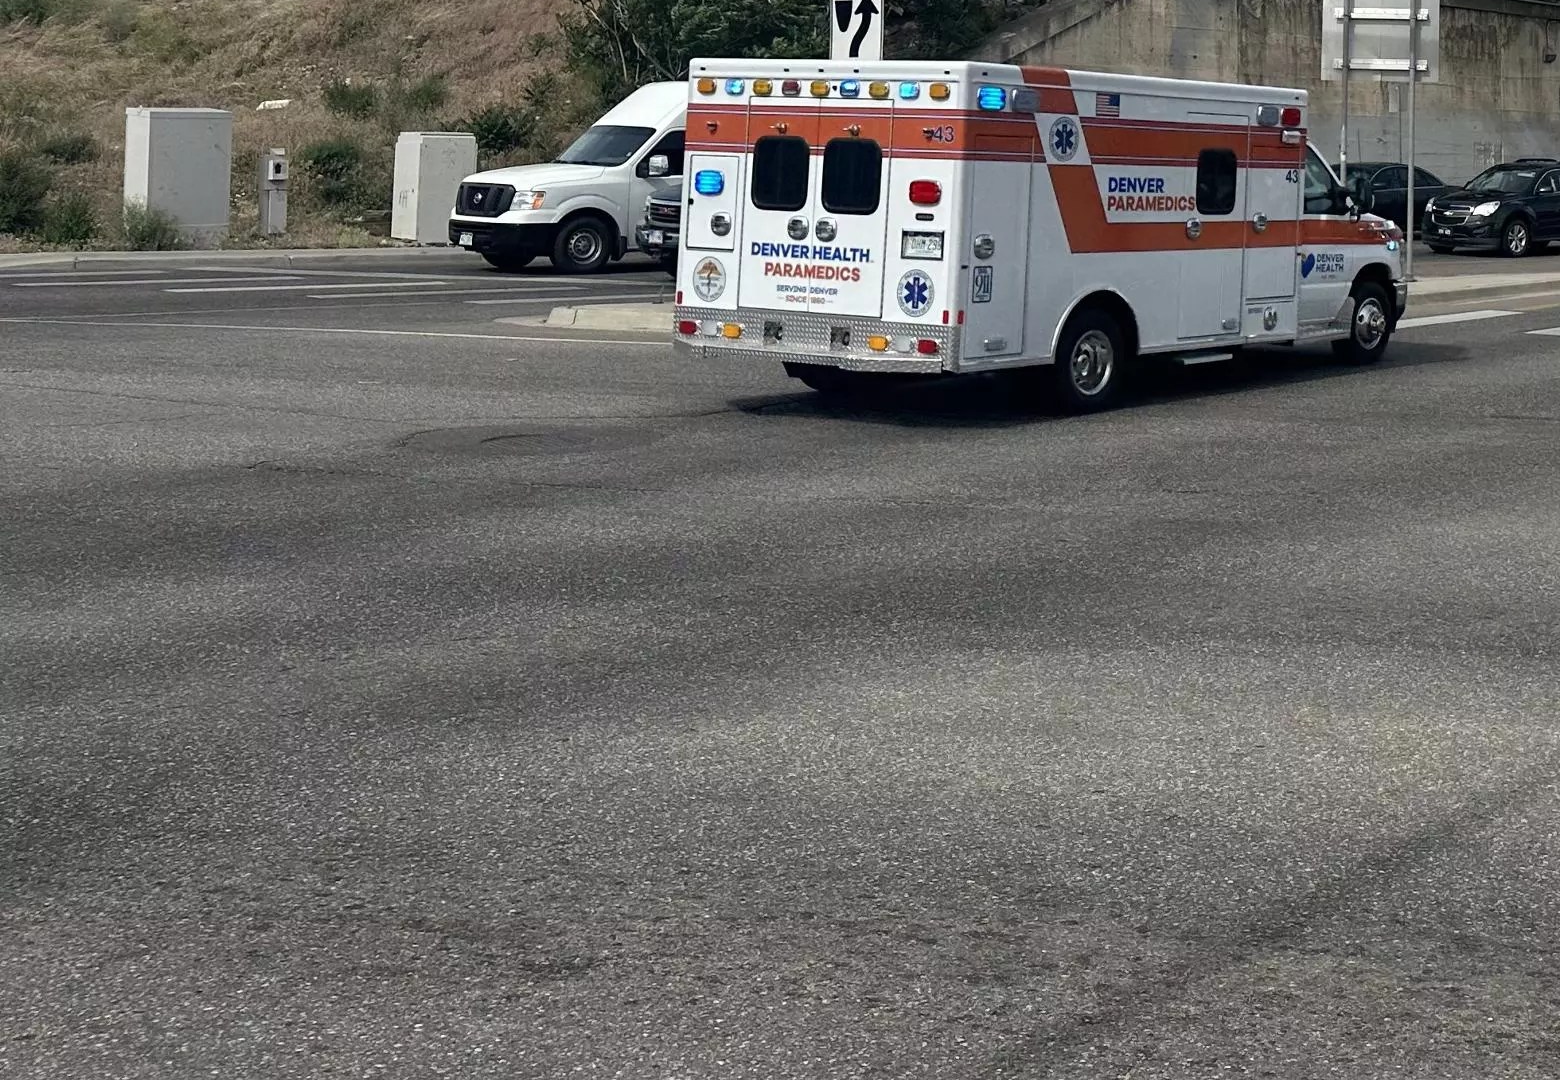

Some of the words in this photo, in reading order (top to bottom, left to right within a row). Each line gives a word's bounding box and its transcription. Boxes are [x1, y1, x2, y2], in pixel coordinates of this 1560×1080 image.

[933, 126, 955, 142] 43
[1108, 176, 1165, 193] DENVER
[1285, 169, 1299, 184] 43
[1107, 195, 1196, 212] PARAMEDICS
[751, 242, 810, 259] DENVER
[812, 245, 871, 263] HEALTH
[1316, 253, 1345, 263] DENVER
[763, 262, 861, 282] PARAMEDICS
[1315, 262, 1345, 273] HEALTH
[775, 284, 807, 294] SERVING
[809, 286, 838, 296] DENVER
